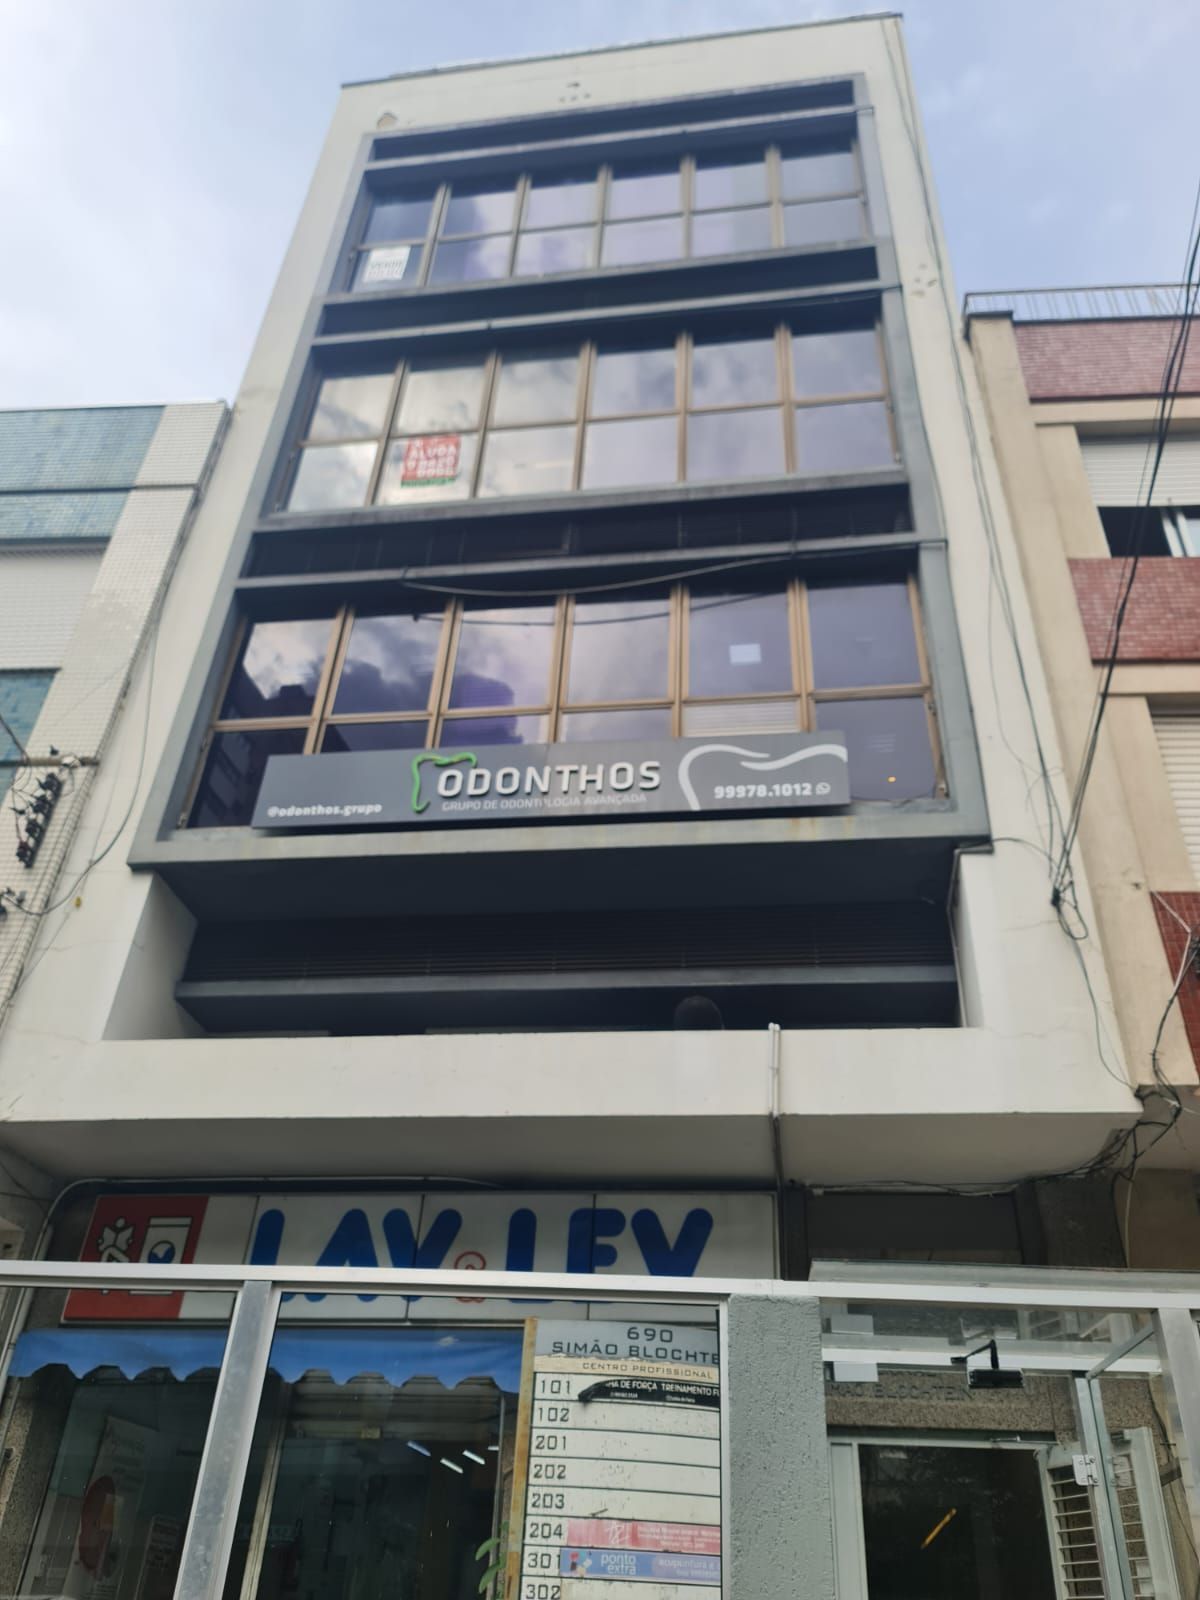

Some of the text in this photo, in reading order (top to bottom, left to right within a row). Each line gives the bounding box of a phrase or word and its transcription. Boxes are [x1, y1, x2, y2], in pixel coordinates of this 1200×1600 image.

[437, 761, 661, 798] ODONTHOS
[714, 783, 812, 799] 99978.1012
[267, 804, 383, 818] @odonthos.grupo
[441, 802, 481, 812] GRUPO
[484, 801, 497, 810] DE
[627, 1326, 674, 1344] 690
[552, 1339, 618, 1355] SIMÃO
[582, 1362, 713, 1380] CENTRO PROFISSIONAL
[541, 1380, 570, 1395] 101
[620, 1381, 631, 1391] DE
[632, 1381, 658, 1392] FORÇA
[661, 1383, 712, 1397] TREINAMENTO
[539, 1408, 569, 1422] 102
[535, 1435, 567, 1450] 201
[533, 1464, 567, 1479] 202
[531, 1493, 565, 1509] 203
[529, 1522, 563, 1539] 204
[527, 1552, 560, 1568] 301
[601, 1553, 636, 1565] ponto
[607, 1563, 636, 1576] extra
[526, 1584, 561, 1600] 302
